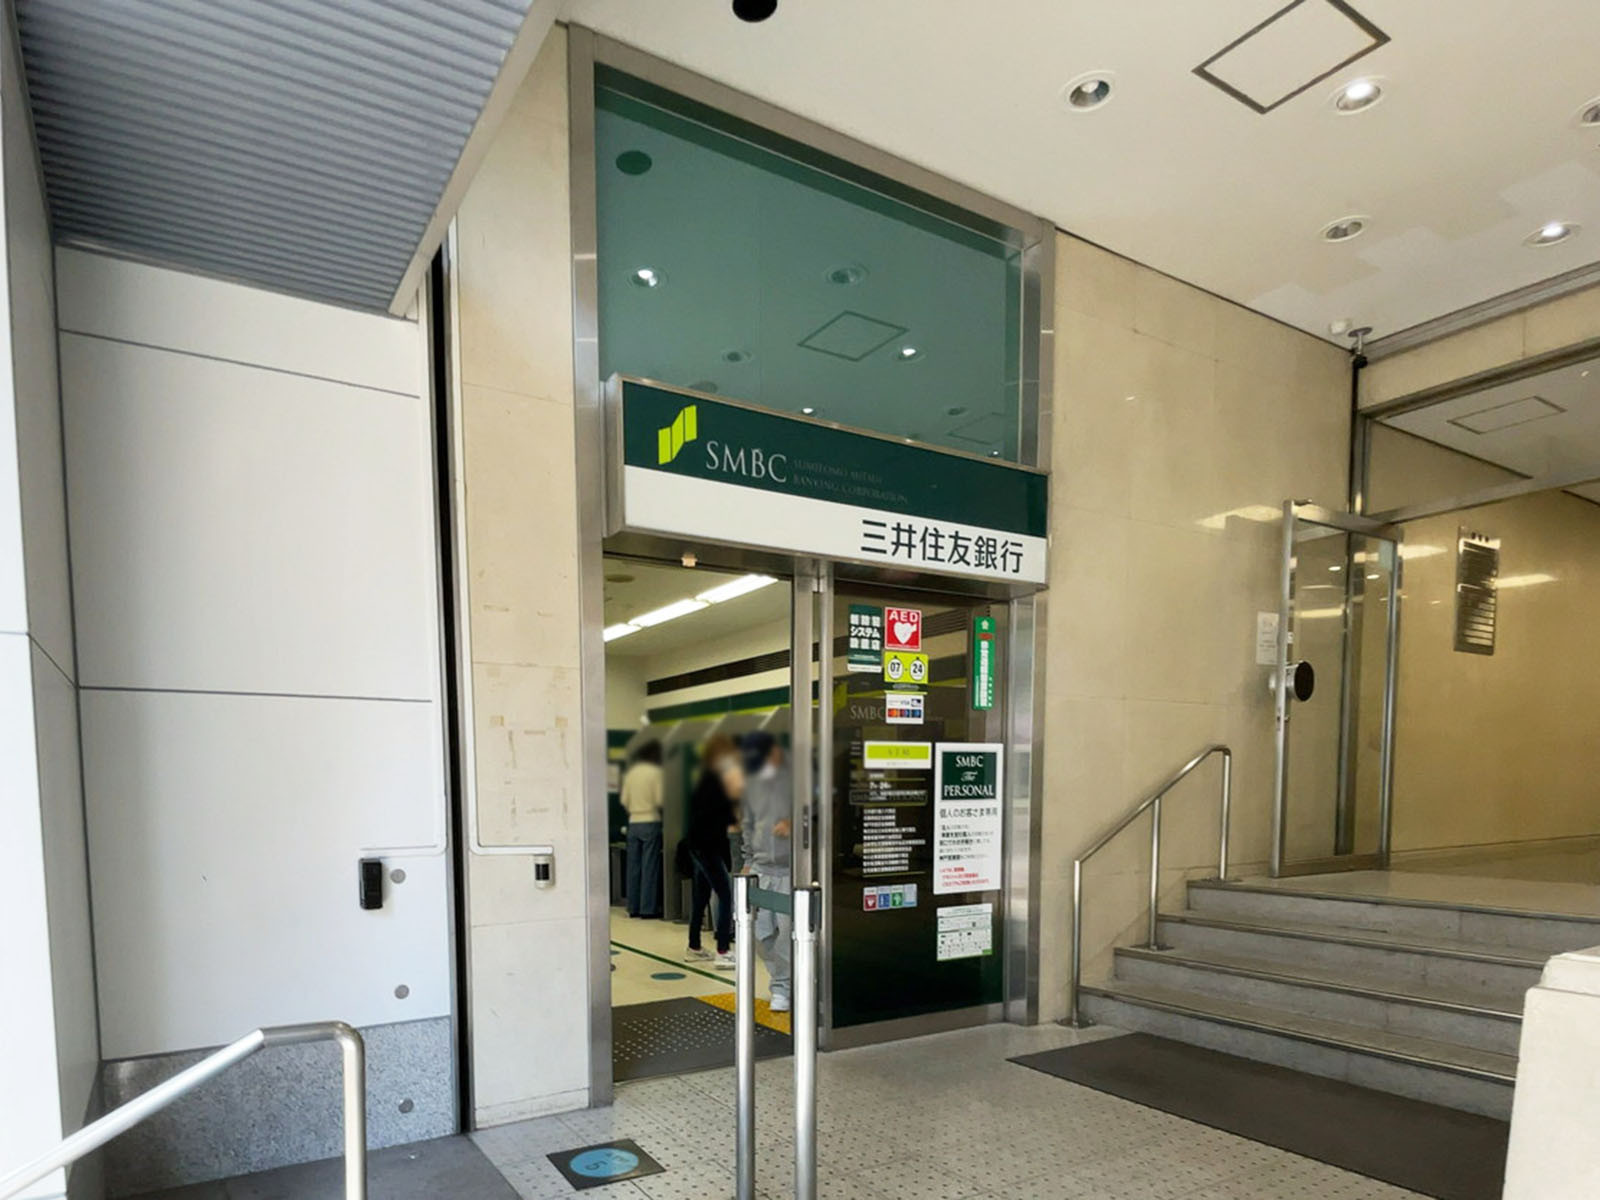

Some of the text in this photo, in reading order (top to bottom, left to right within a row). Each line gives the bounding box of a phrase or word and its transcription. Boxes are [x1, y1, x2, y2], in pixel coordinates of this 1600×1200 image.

[705, 440, 788, 484] SMBC
[860, 518, 1023, 574] 三井住友銀行
[889, 610, 919, 623] AED
[850, 626, 880, 639] システム
[890, 661, 901, 670] 07
[912, 662, 923, 674] 24
[955, 754, 984, 768] SMBC
[943, 784, 995, 797] PERSONAL
